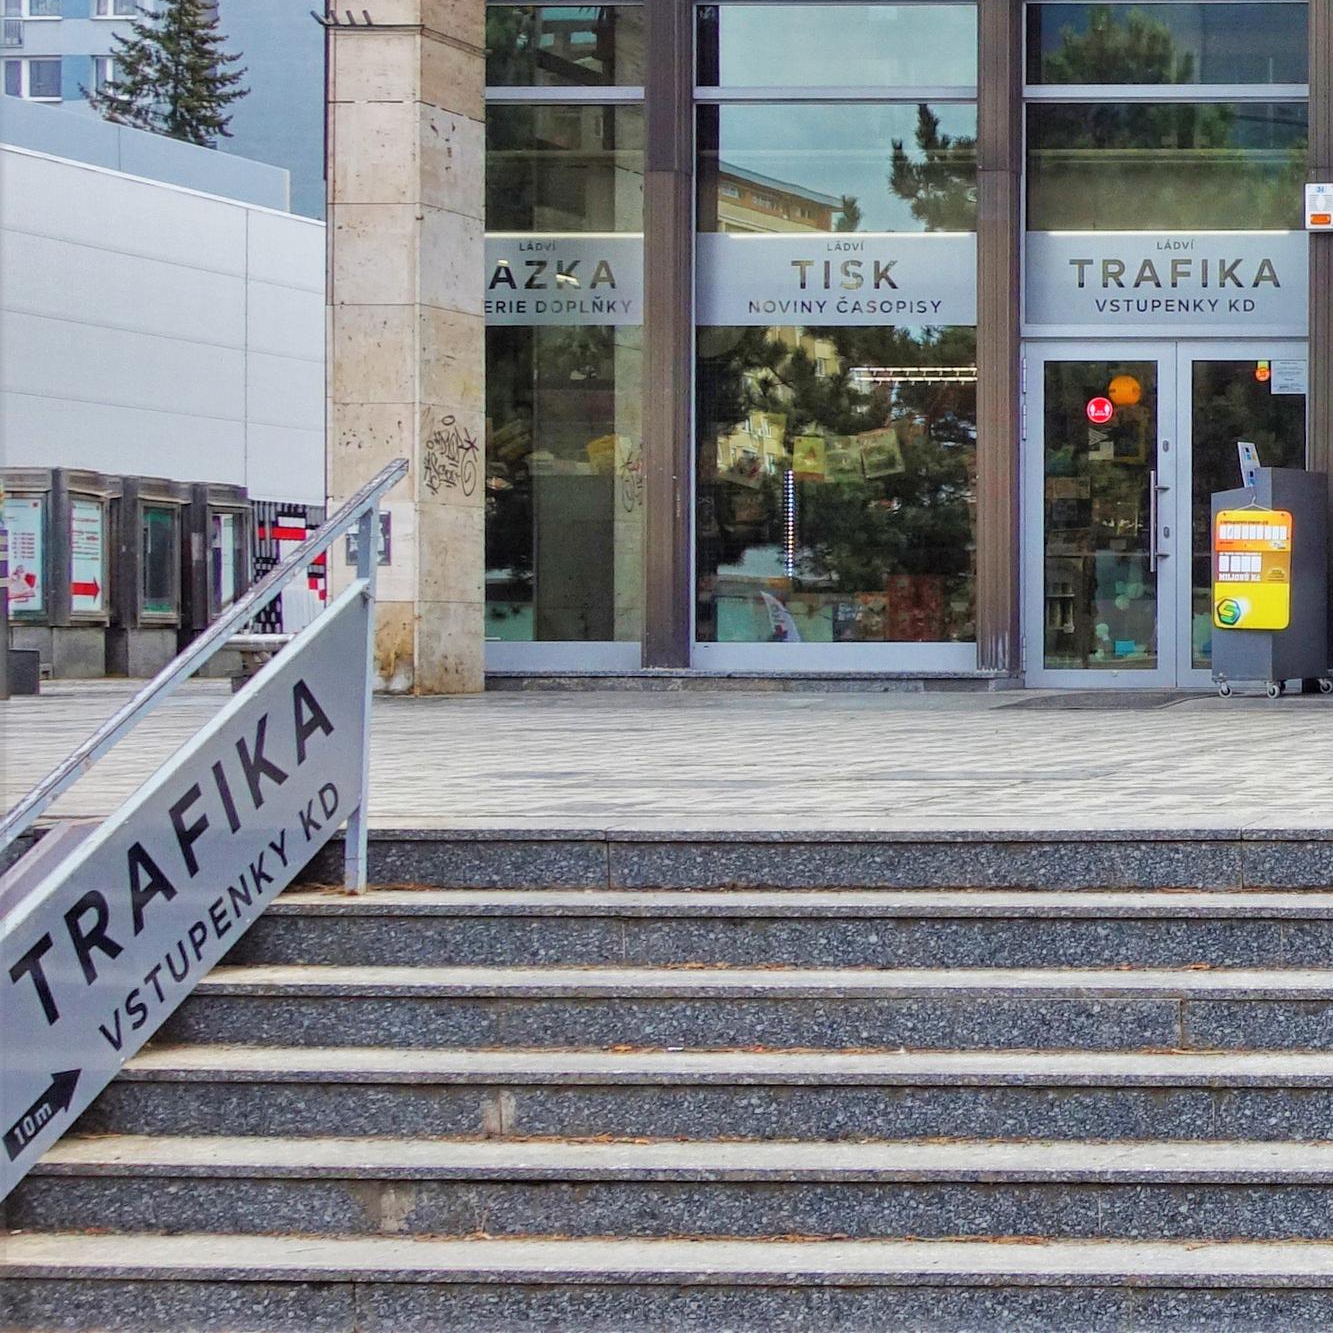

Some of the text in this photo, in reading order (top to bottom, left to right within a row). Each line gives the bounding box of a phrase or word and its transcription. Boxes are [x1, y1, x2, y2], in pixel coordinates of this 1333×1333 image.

[519, 241, 556, 252] LÁDVÍ
[826, 240, 864, 251] LÁDVÍ
[1156, 238, 1194, 250] LÁDVÍ
[791, 259, 899, 290] TISK
[1069, 258, 1281, 288] TRAFIKA
[535, 295, 633, 313] DOPLŇKY
[748, 296, 942, 313] NOVINY ČASOPISY
[1095, 299, 1256, 312] VSTUPENKY KD
[10, 678, 335, 1026] TRAFIKA
[98, 782, 339, 1051] VSTUPENKY KD
